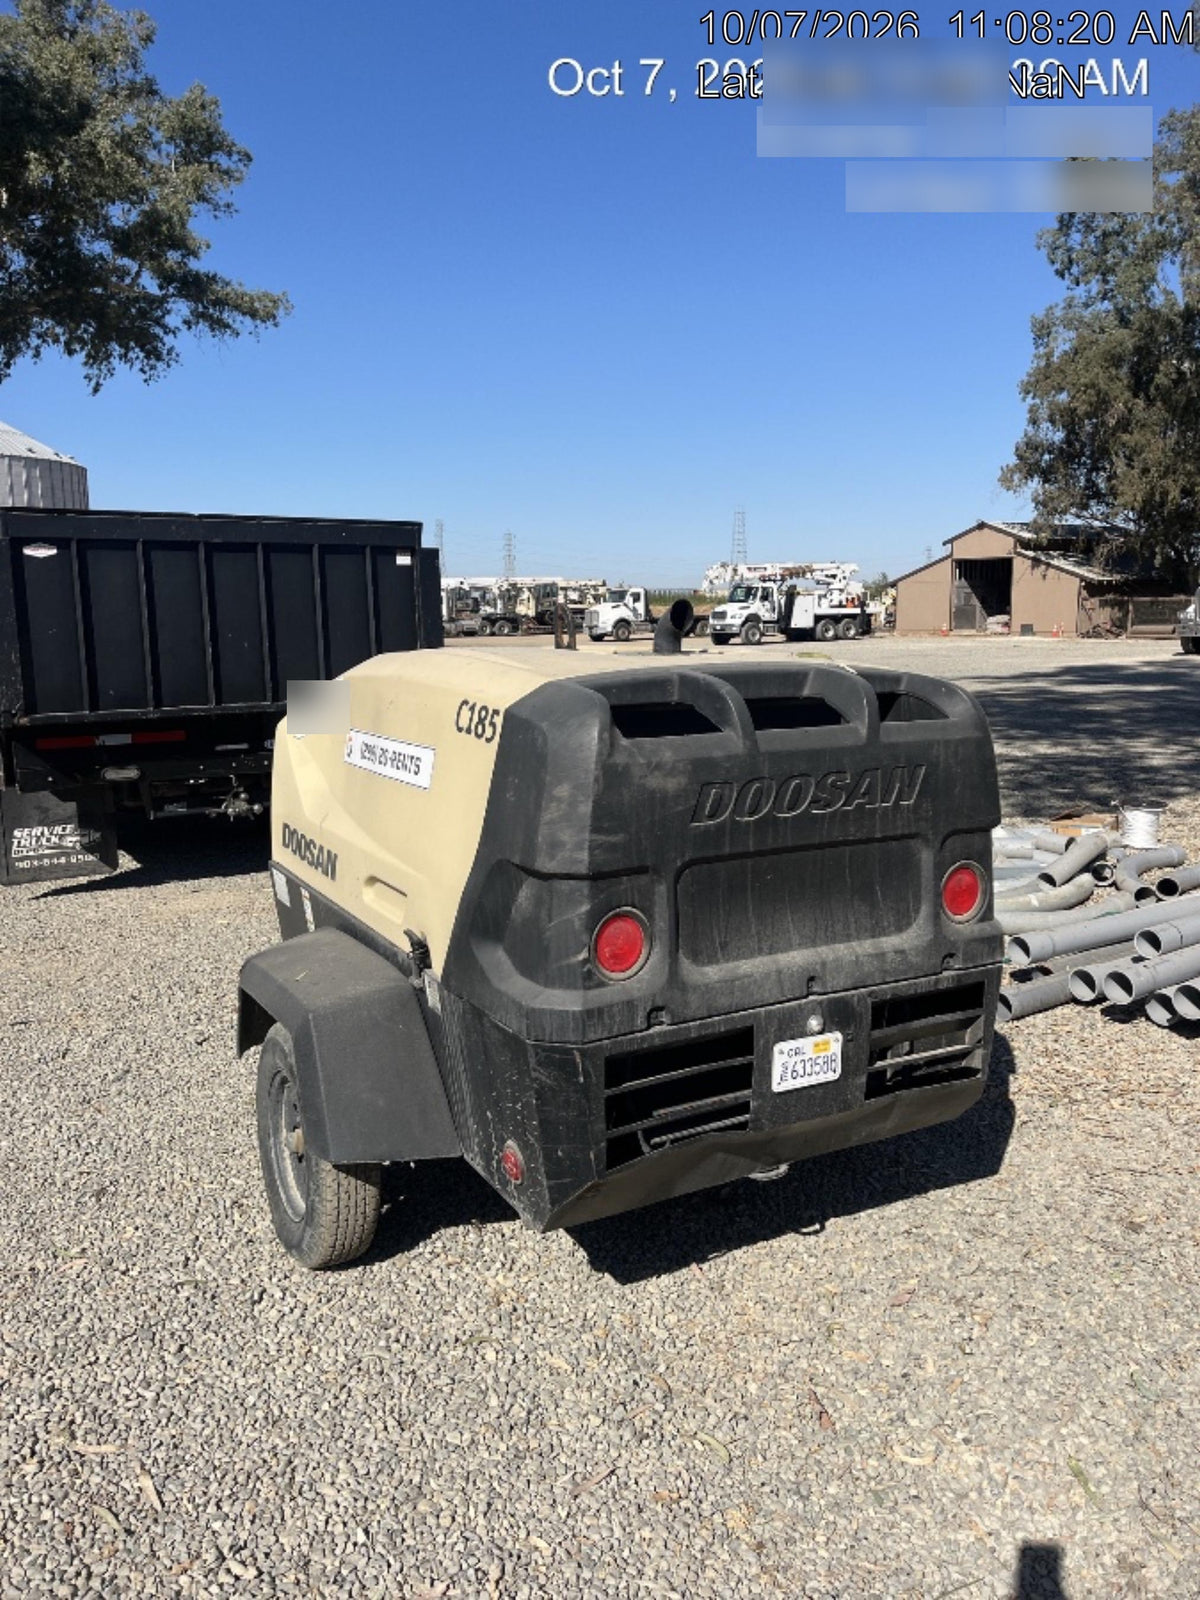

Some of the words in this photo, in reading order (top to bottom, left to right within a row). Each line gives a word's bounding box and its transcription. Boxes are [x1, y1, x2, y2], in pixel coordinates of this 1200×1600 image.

[456, 699, 500, 743] C185
[690, 764, 926, 826] DOOSAN
[11, 835, 60, 849] TRUCK
[13, 824, 75, 838] SERVICE
[282, 822, 338, 881] DOOSAN
[787, 1046, 806, 1059] CAL
